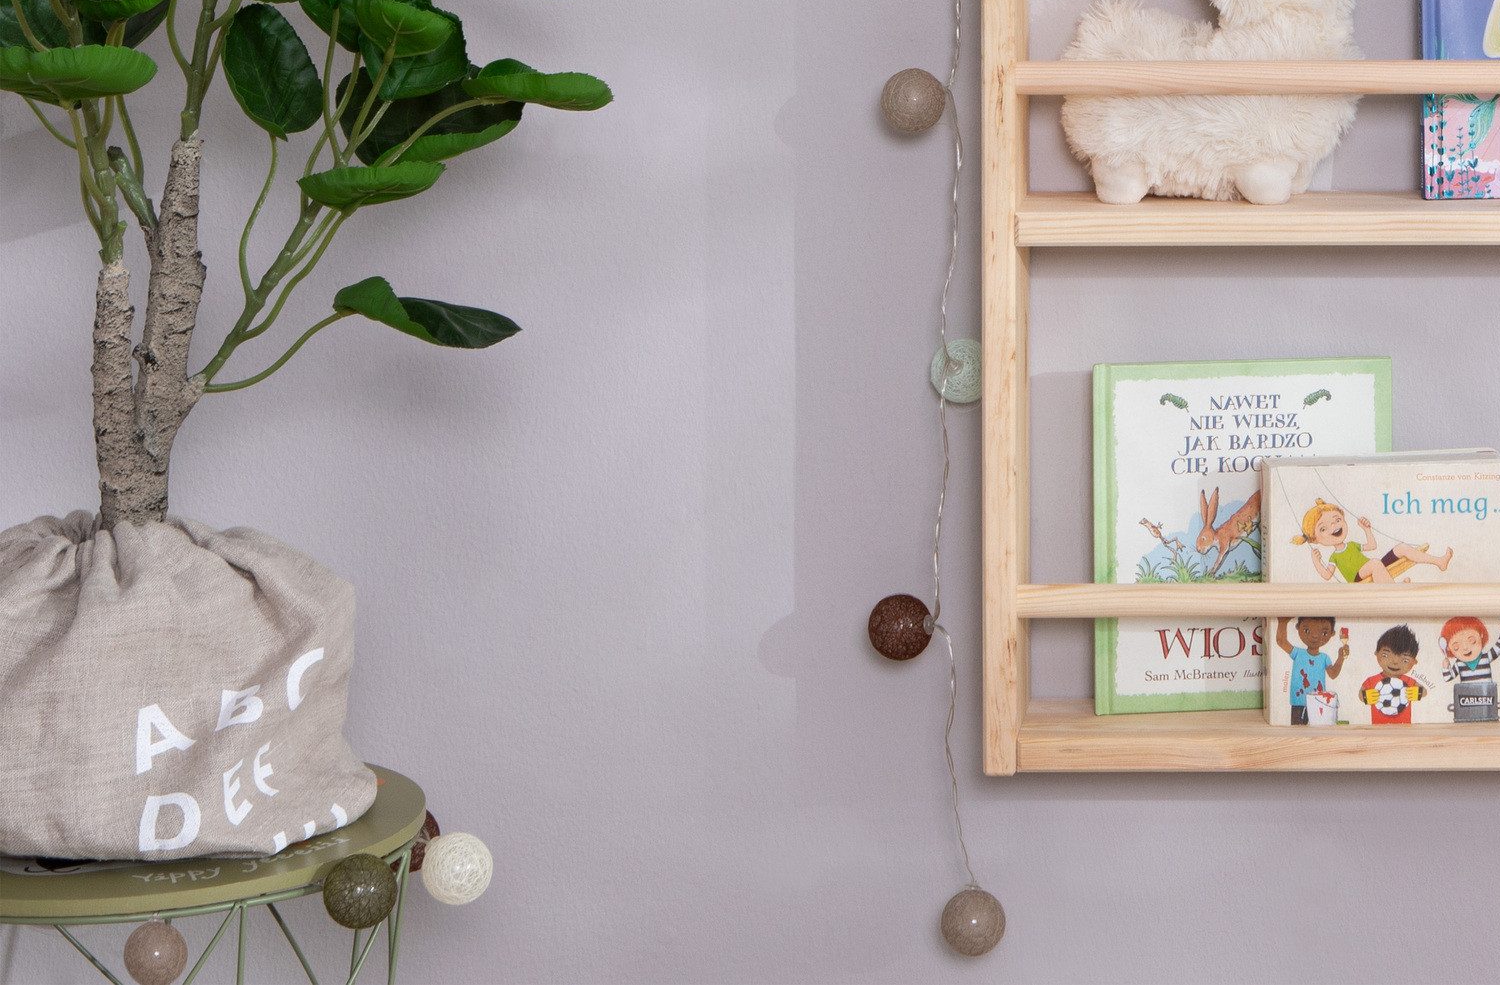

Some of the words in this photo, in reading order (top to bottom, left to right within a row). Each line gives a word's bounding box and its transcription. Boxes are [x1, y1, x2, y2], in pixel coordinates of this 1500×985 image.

[1210, 393, 1281, 411] NAWET
[1190, 415, 1225, 431] NIE
[1232, 413, 1300, 430] WIESZ,
[1177, 434, 1222, 457] JAK
[1228, 431, 1314, 452] BARDZO
[1171, 456, 1209, 476] CIĘ
[1416, 472, 1456, 482] Constanze
[1457, 473, 1472, 481] von
[1382, 490, 1422, 515] Ich
[1144, 669, 1170, 683] Sam
[1174, 667, 1237, 682] McBratney
[1459, 696, 1494, 707] CARLSEN
